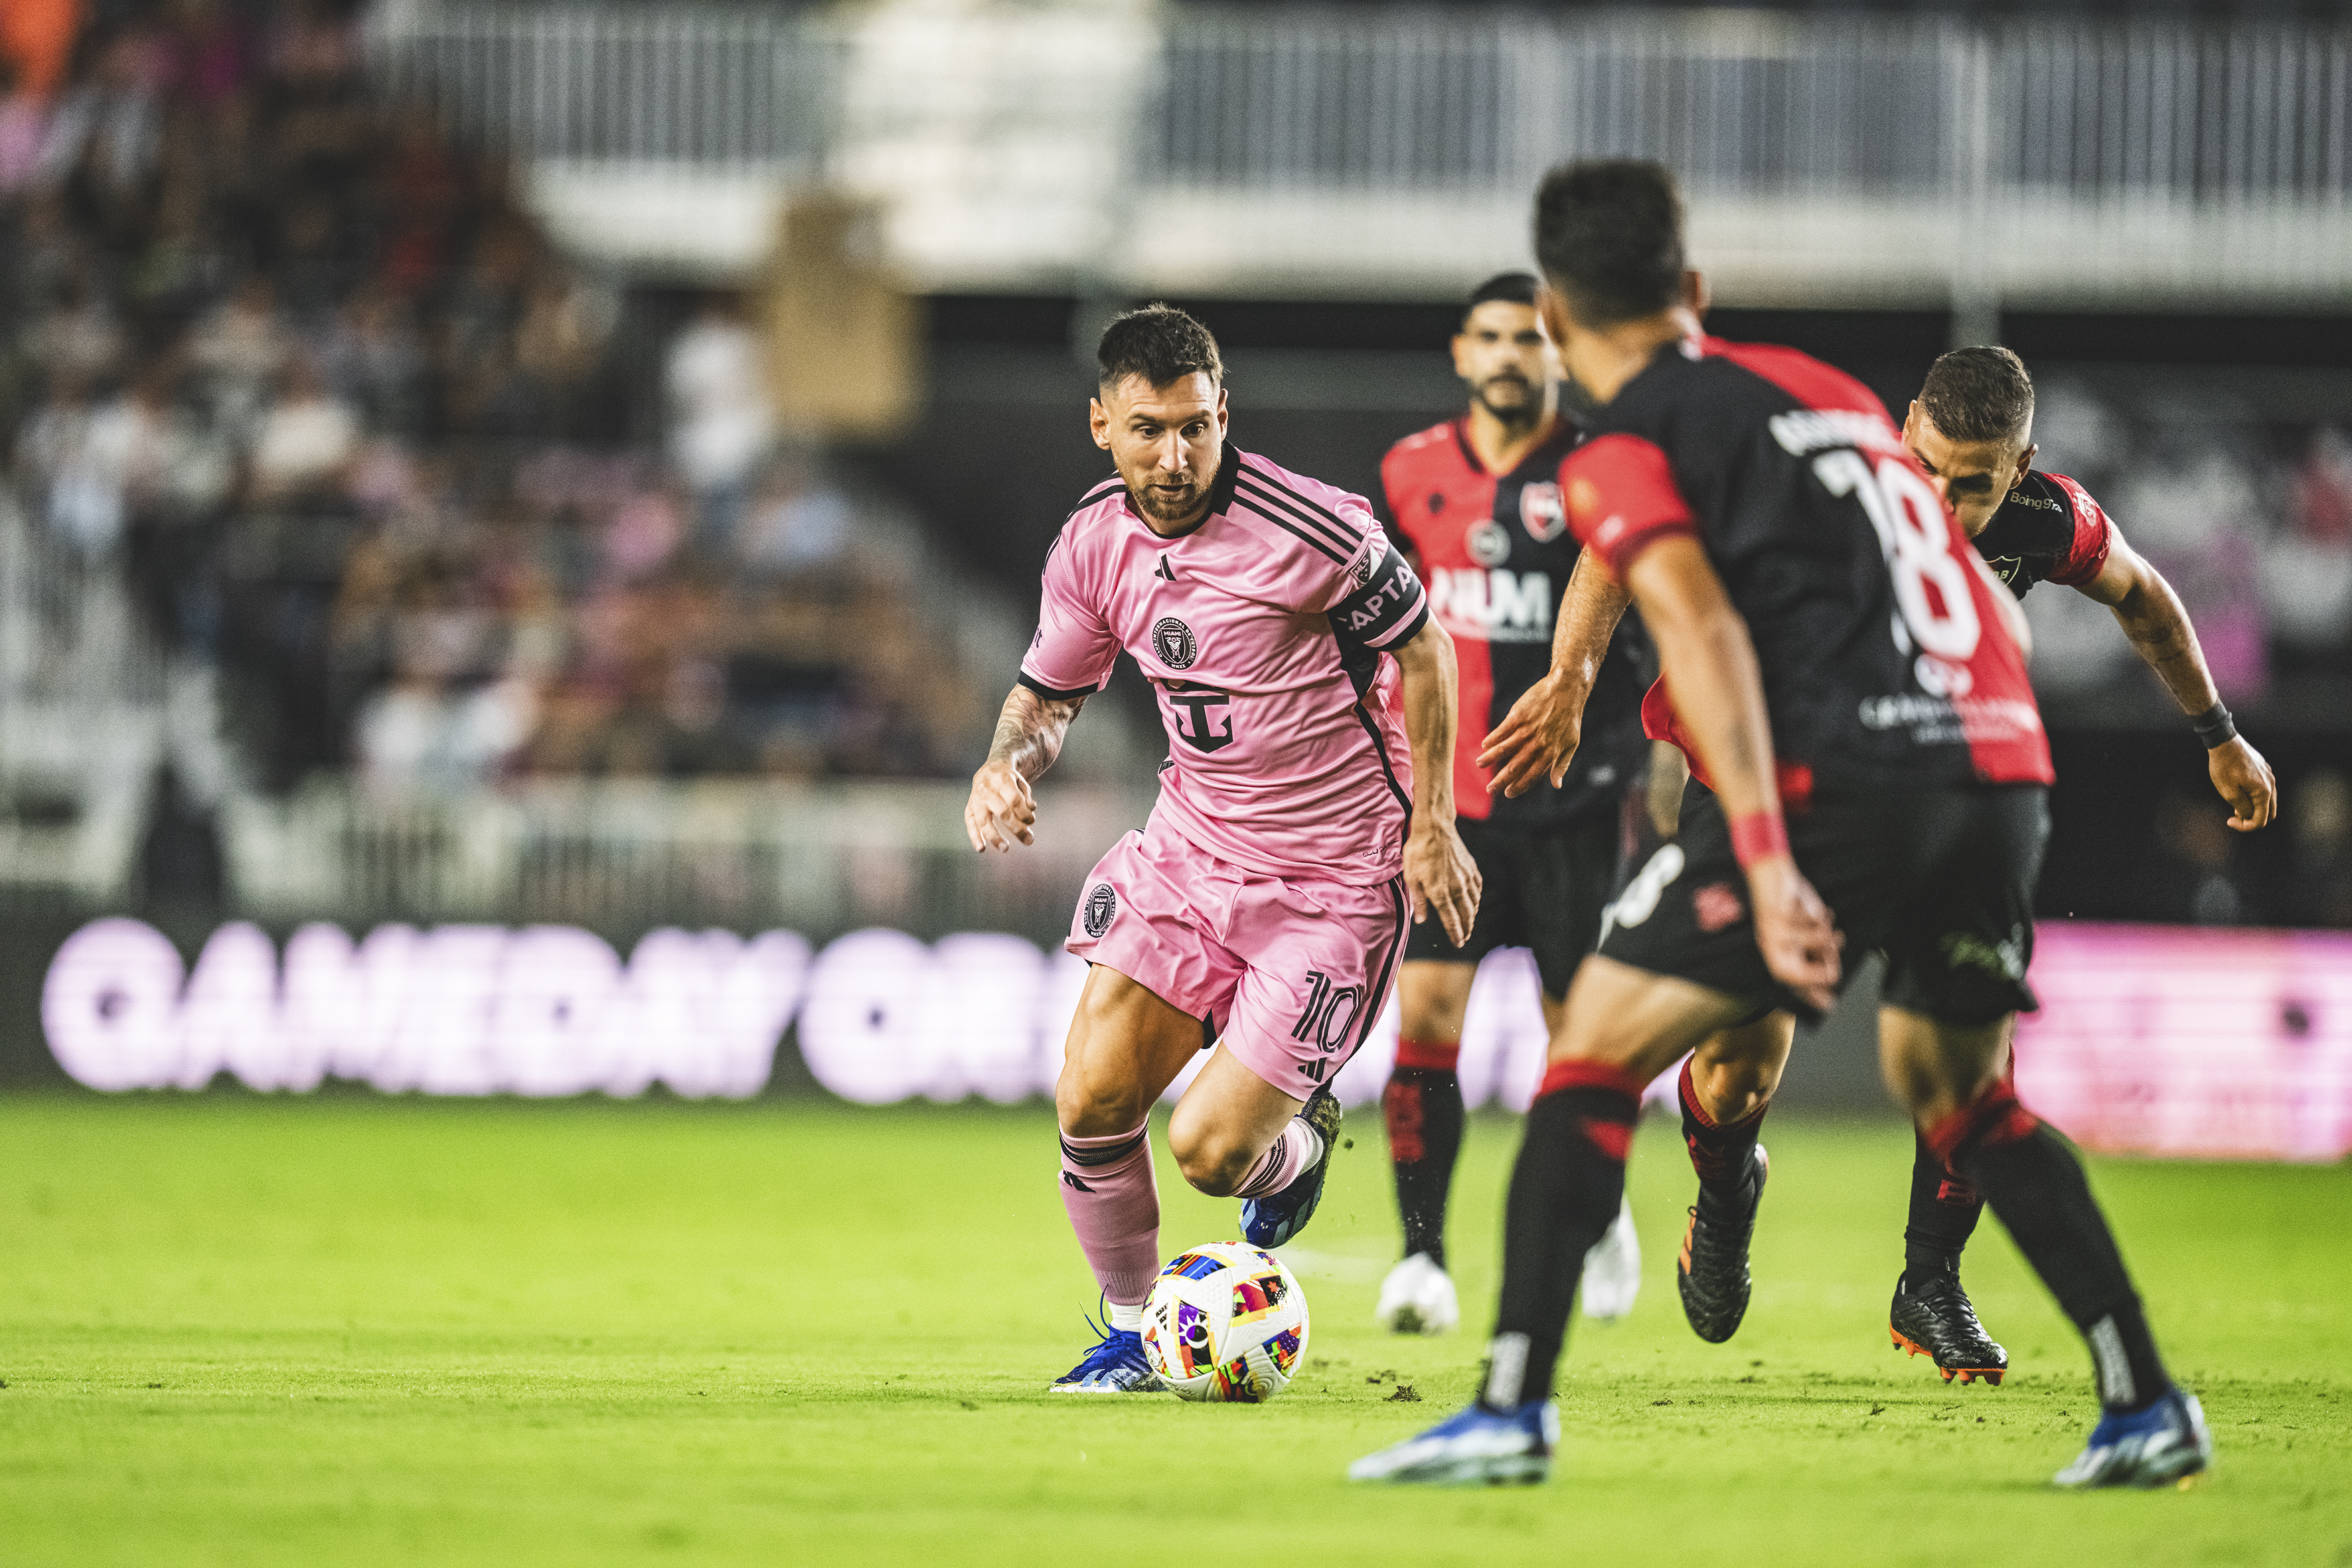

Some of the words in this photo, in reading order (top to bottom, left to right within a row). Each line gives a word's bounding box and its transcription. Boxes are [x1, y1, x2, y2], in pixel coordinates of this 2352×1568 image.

[1354, 557, 1370, 576] MLS
[1812, 449, 1982, 663] 18
[1291, 969, 1362, 1054] 10
